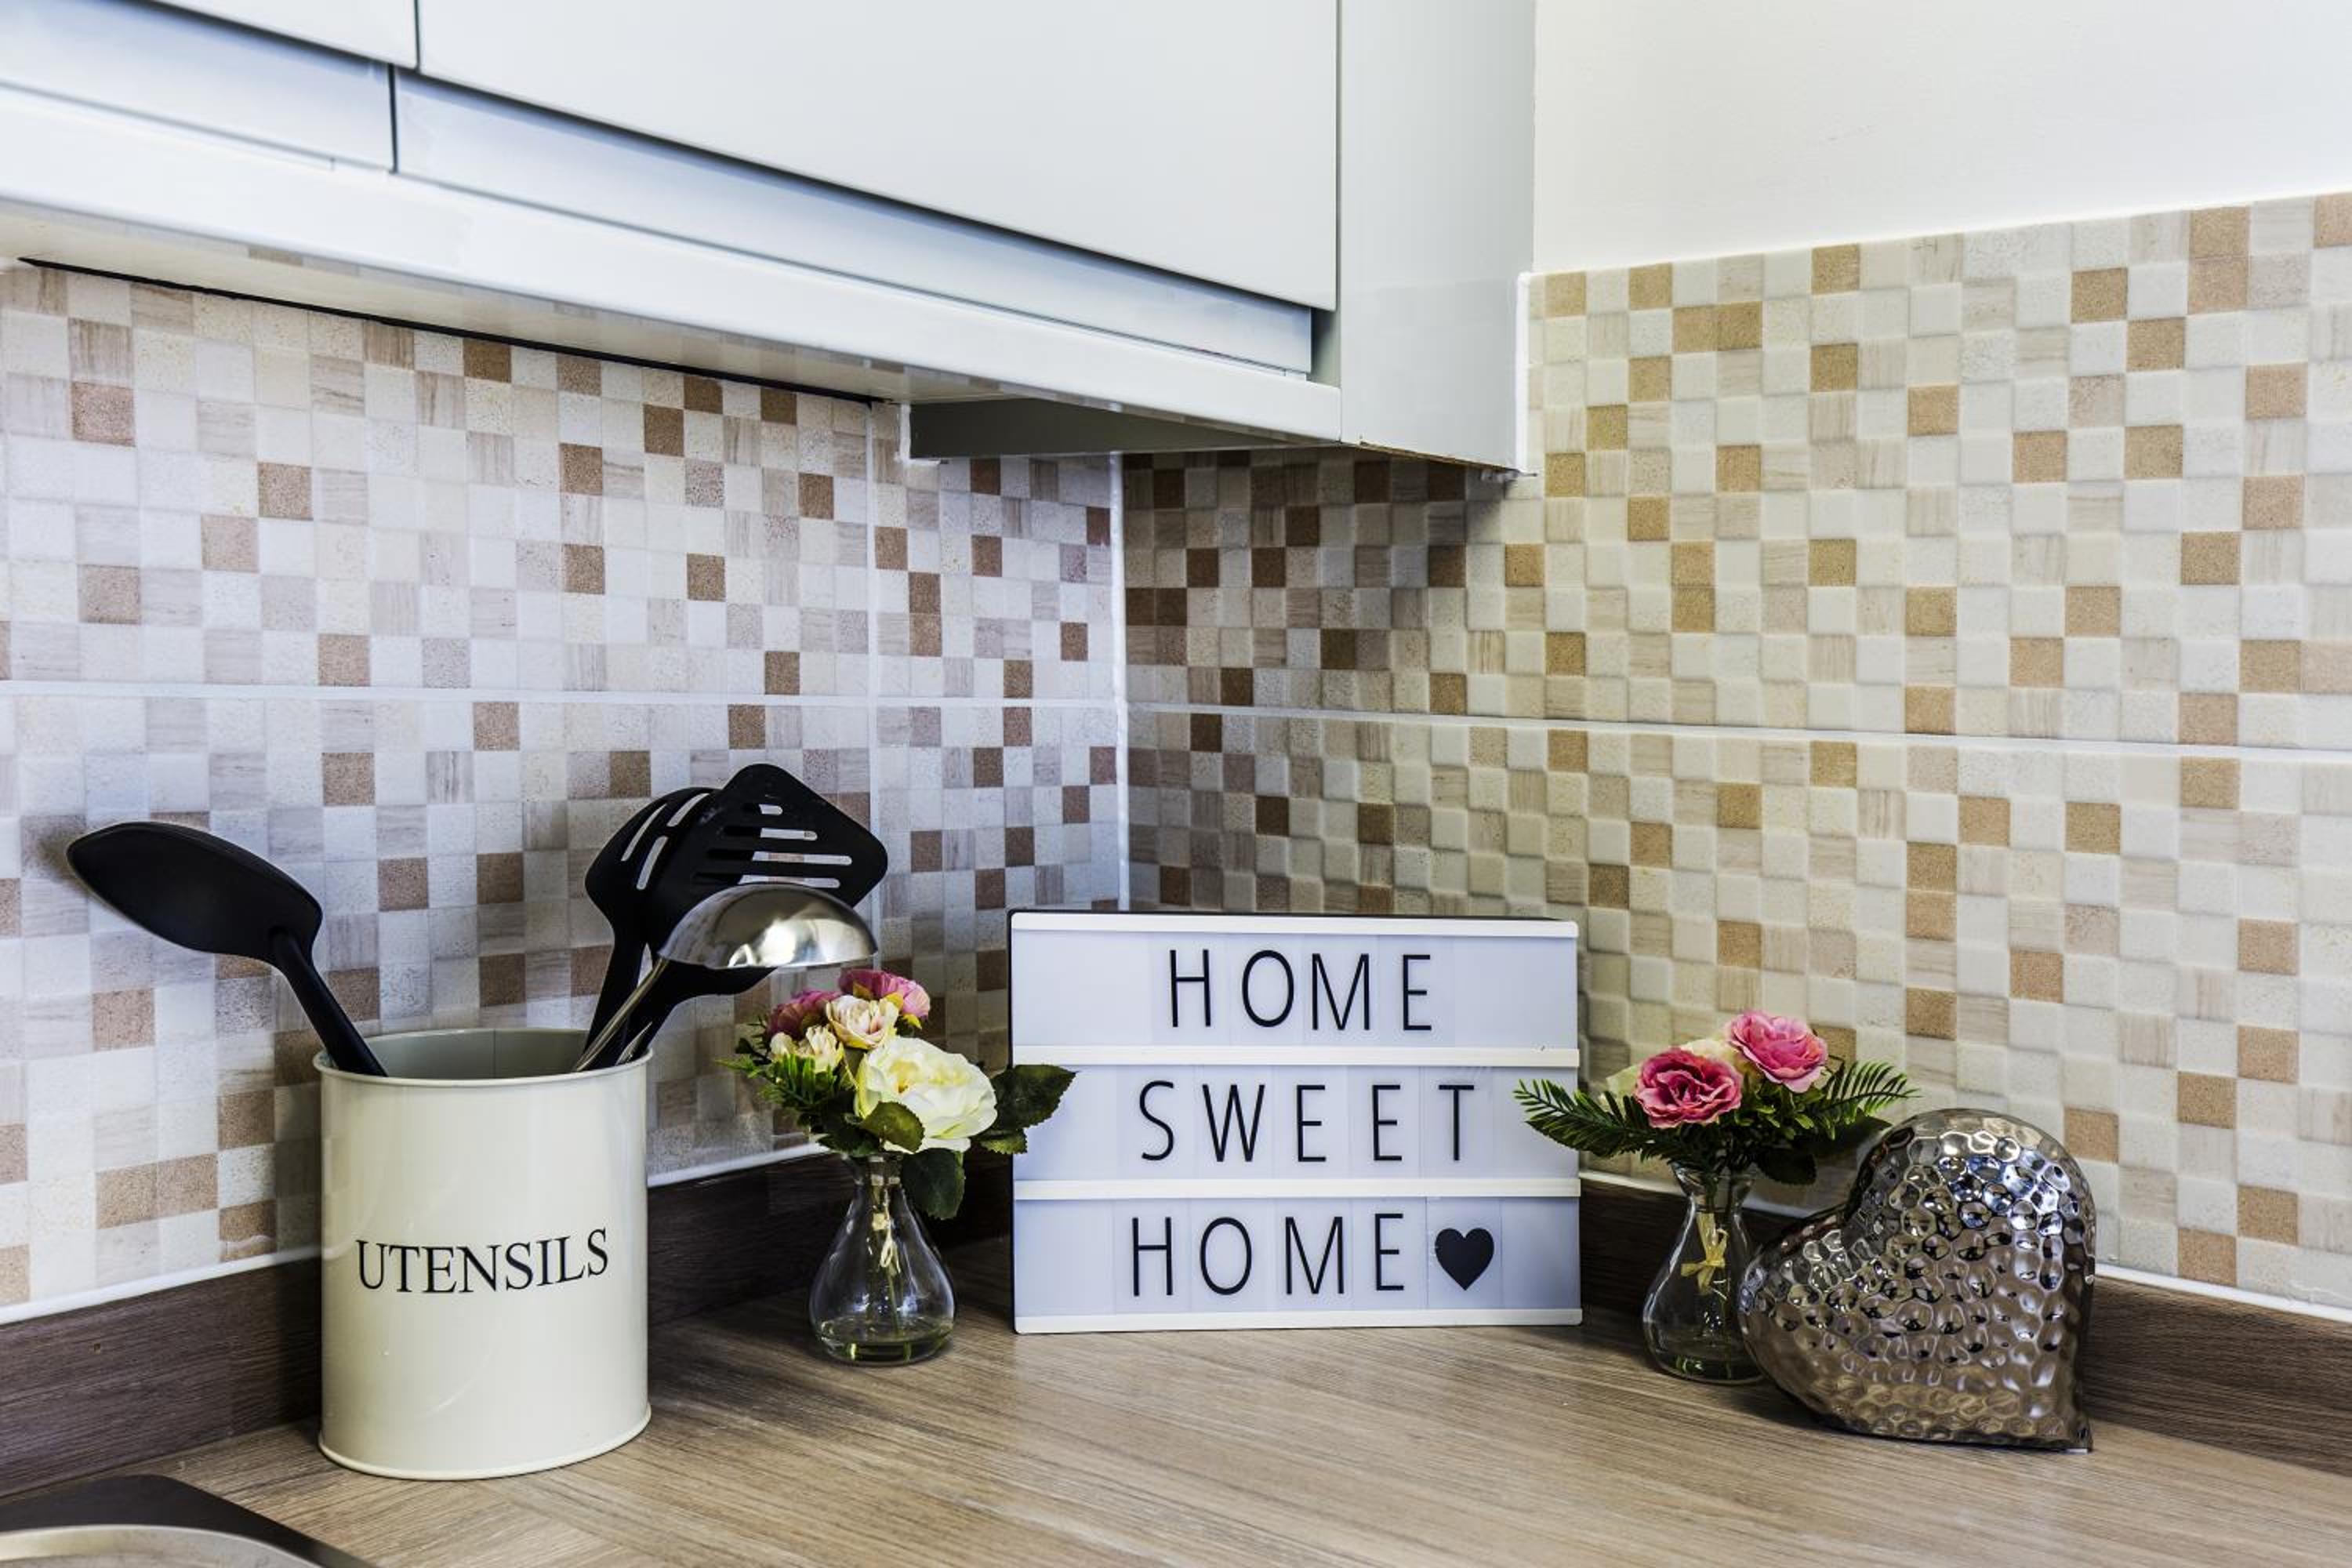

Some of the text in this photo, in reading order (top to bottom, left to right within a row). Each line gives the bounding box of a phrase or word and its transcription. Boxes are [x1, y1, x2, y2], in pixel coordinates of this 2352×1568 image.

[1169, 948, 1432, 1031] HOME
[1139, 1080, 1475, 1163] SWEET
[355, 1228, 609, 1294] UTENSILS
[1131, 1212, 1405, 1297] HOME
